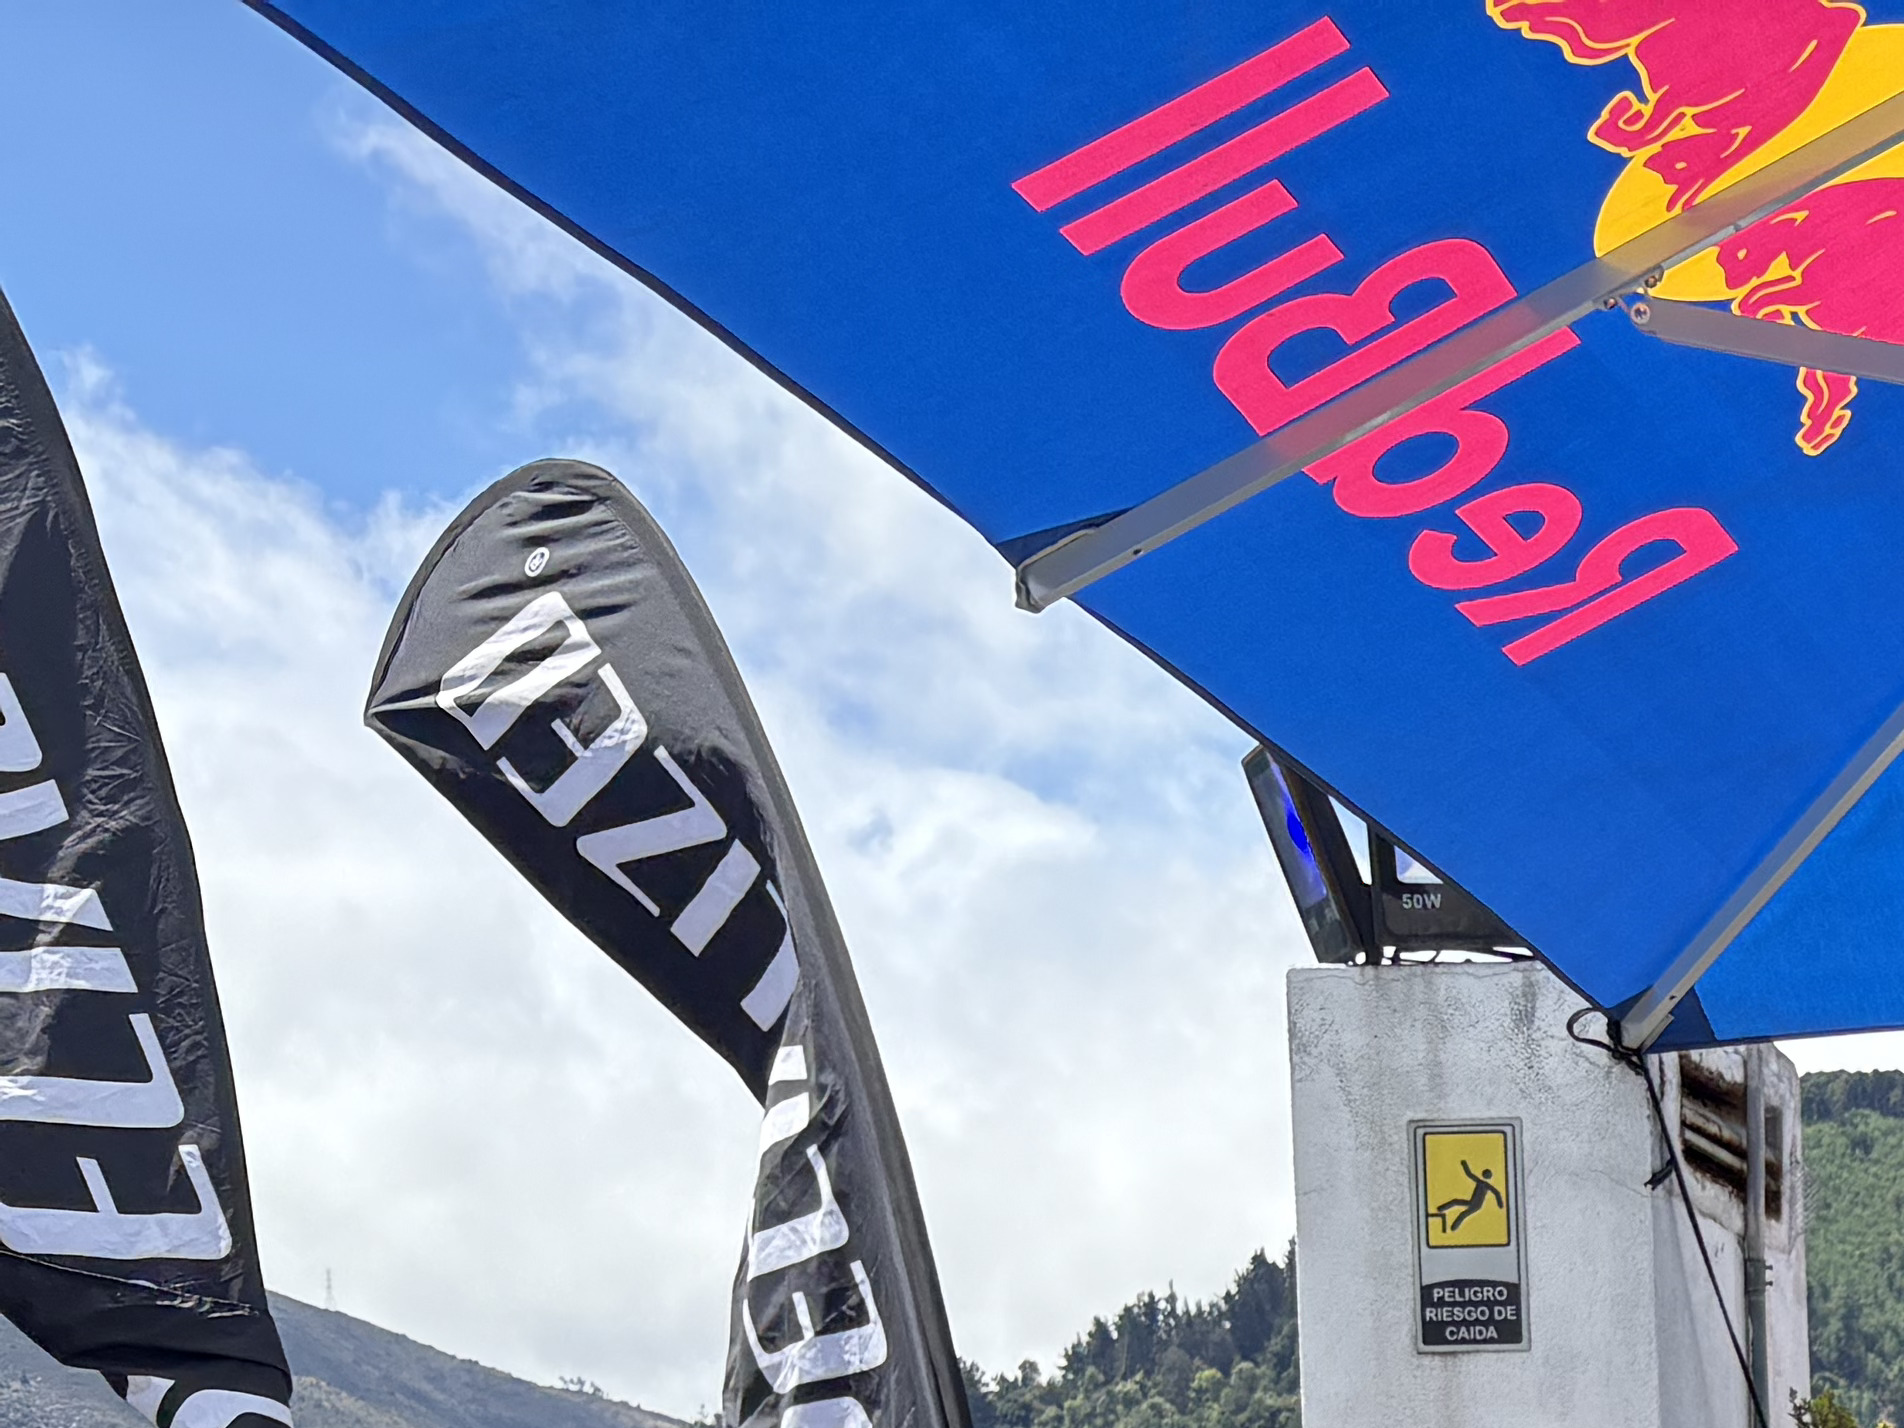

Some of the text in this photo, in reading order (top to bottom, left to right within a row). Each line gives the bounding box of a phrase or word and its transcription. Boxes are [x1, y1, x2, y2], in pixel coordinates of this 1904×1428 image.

[1402, 893, 1441, 909] 50W
[1433, 1287, 1508, 1302] PELIGRO
[1425, 1305, 1517, 1322] RIESGO DE
[1445, 1326, 1498, 1341] CAIDA
